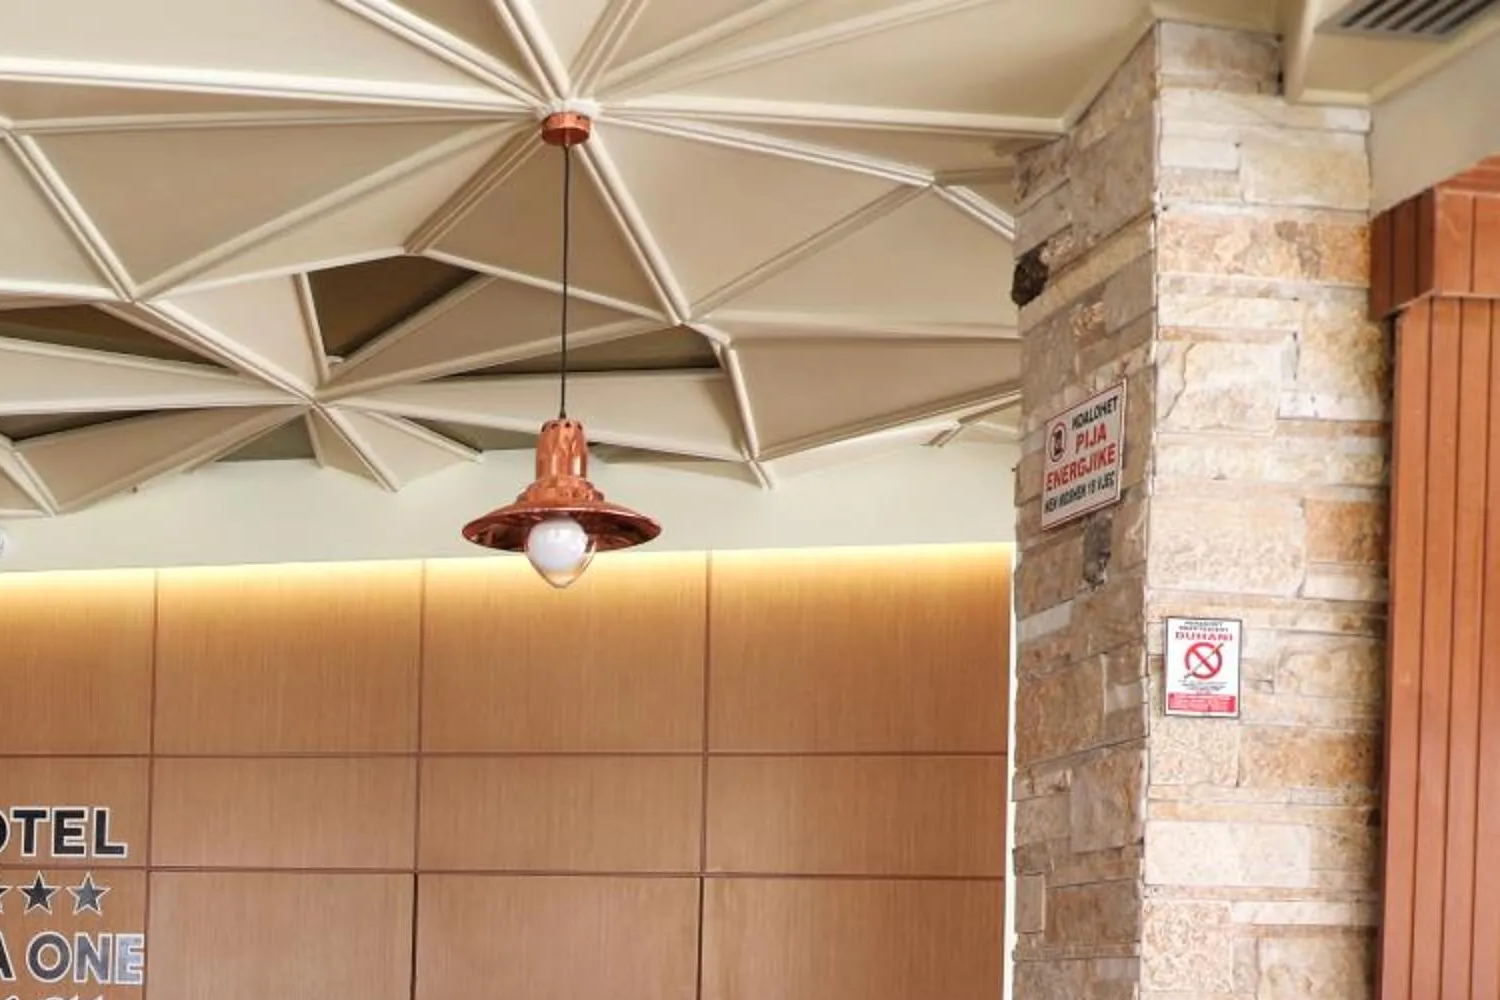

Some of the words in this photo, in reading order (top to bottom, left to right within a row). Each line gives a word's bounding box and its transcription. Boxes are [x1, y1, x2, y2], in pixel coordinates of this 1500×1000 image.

[1075, 422, 1107, 454] PIJA
[1046, 443, 1117, 492] ENERGJIKE
[25, 931, 145, 985] ONE
